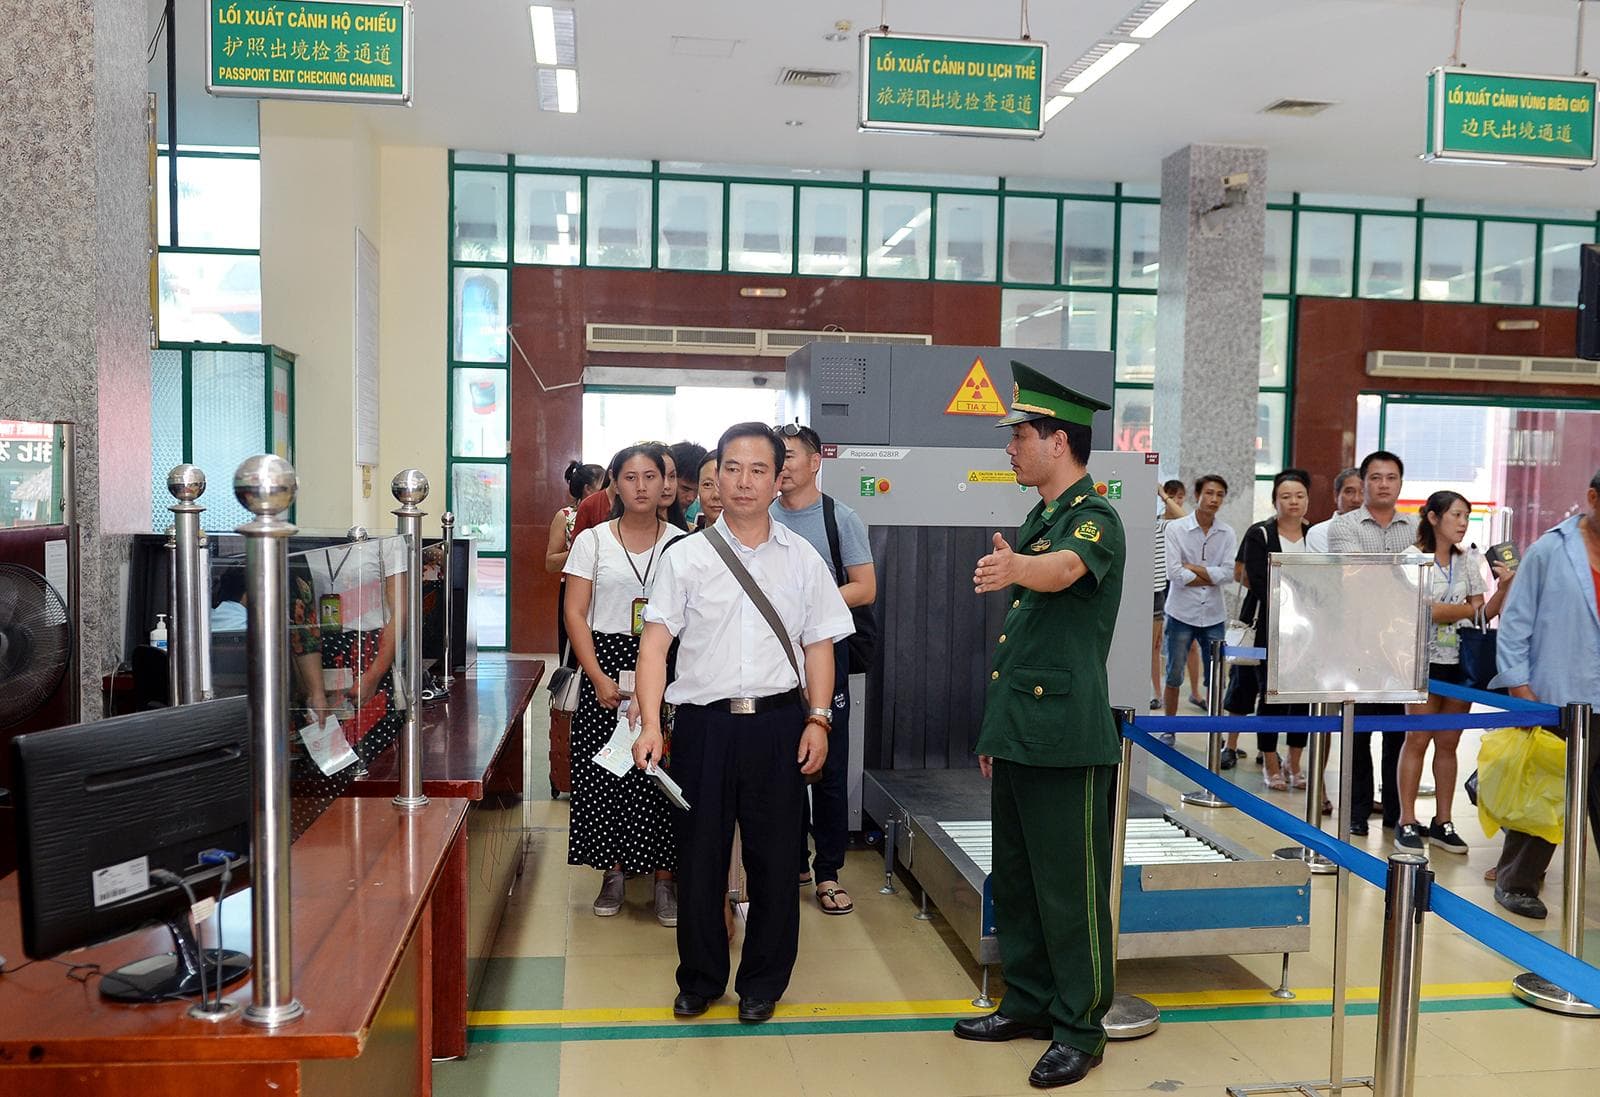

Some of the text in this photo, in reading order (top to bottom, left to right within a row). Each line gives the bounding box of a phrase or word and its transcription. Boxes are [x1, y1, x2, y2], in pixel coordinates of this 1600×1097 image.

[219, 3, 397, 34] LỐI XUẤT CẢNH HỘ CHIẾU
[222, 35, 392, 65] 护照出境检查通道
[219, 66, 395, 88] PASSPORT EXIT CHECKING CHANNEL
[877, 51, 1036, 82] LỐI XUẤT CẢNH DU LỊCH THẺ
[876, 87, 1033, 114] 旅游团出境检查通道
[1449, 85, 1463, 104] LỐI
[1466, 87, 1491, 105] XUẤT
[1493, 89, 1518, 107] CẢNH
[1462, 118, 1572, 143] 边民出境通道
[981, 403, 987, 411] X
[850, 450, 878, 458] Rapiscan
